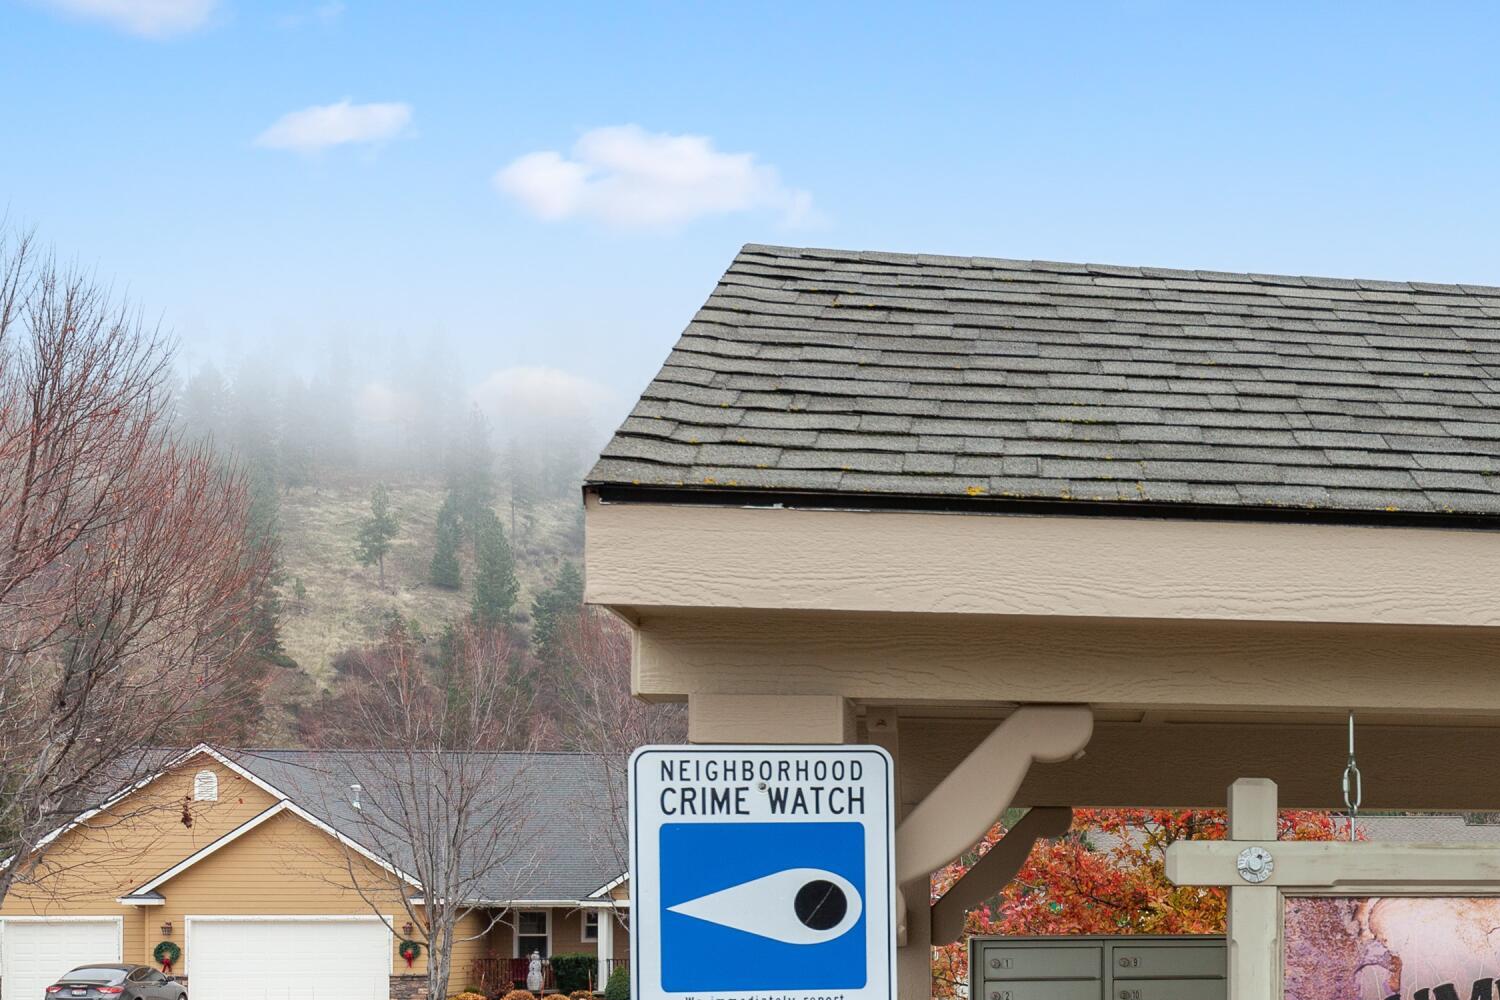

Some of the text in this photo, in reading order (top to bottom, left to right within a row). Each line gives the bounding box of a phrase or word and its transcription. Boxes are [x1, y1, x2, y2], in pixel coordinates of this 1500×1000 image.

[660, 759, 863, 782] NEIGHBORHOOD
[659, 786, 865, 816] CRIME WATCH
